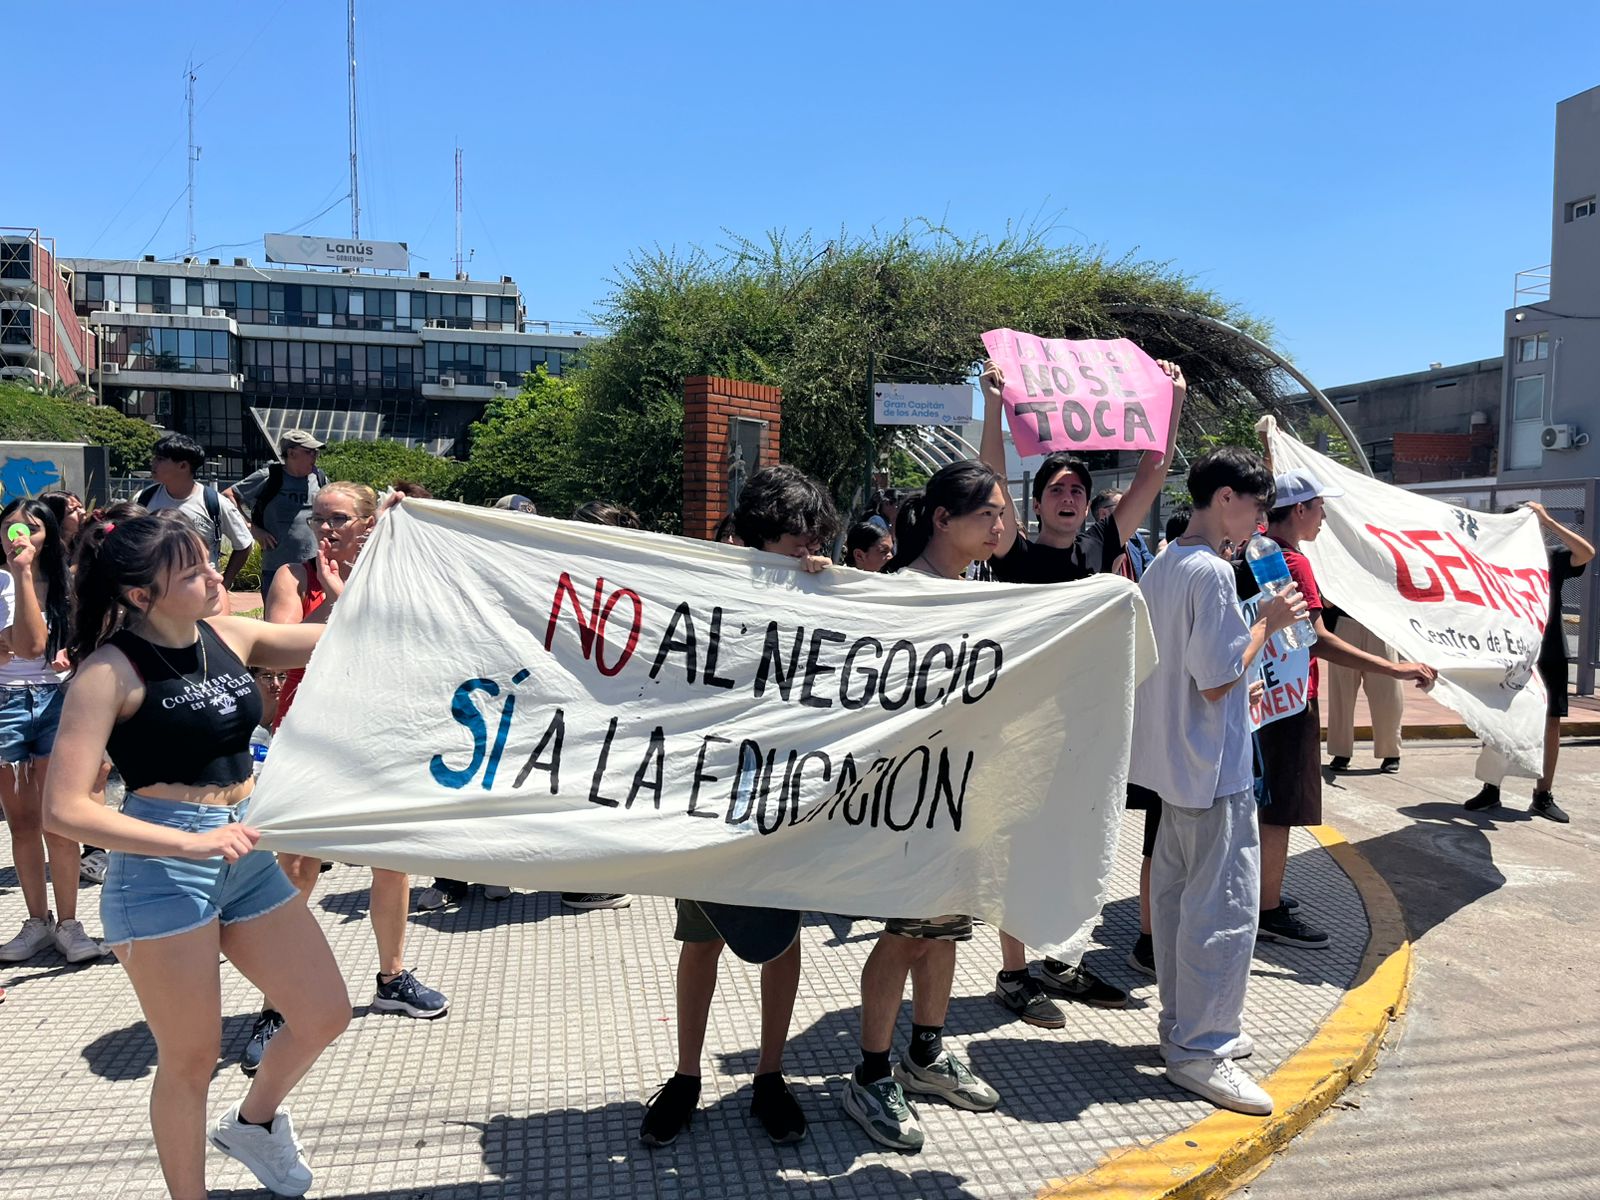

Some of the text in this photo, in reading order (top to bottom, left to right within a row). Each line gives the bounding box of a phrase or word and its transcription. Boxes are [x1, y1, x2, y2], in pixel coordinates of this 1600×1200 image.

[327, 243, 374, 255] Lanús
[907, 401, 945, 410] Capitán
[1014, 400, 1157, 443] TOCA
[544, 571, 642, 677] NO
[649, 602, 735, 689] AL
[1409, 618, 1481, 652] Centro
[1486, 629, 1502, 654] de
[161, 683, 228, 709] COUNTRY
[183, 672, 233, 694] PLAYBOY
[190, 701, 206, 711] EST
[429, 668, 975, 837] SÍ A LA EDUCACIÓN
